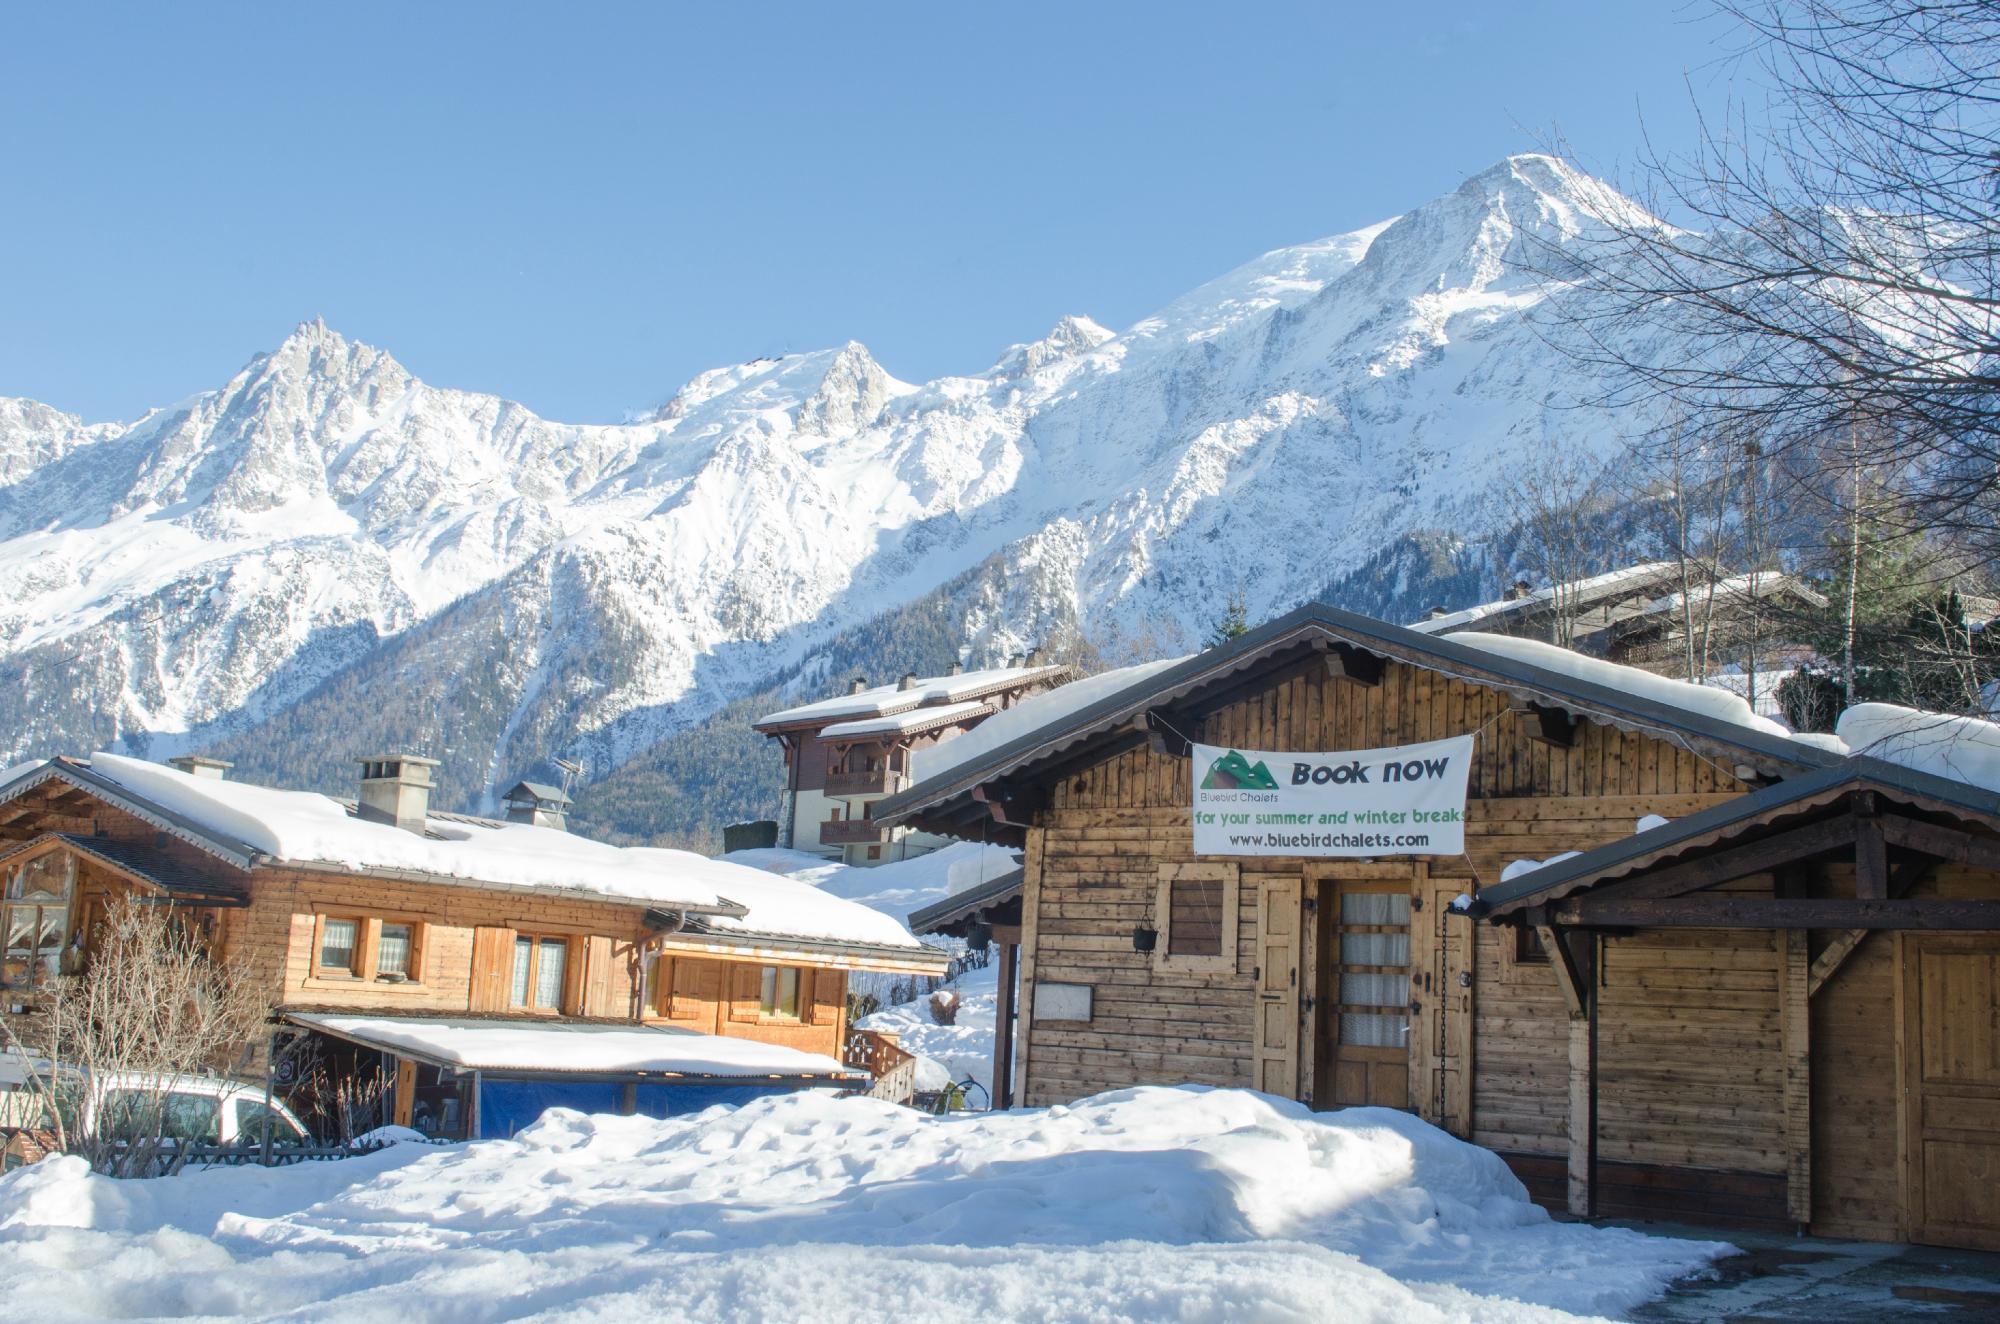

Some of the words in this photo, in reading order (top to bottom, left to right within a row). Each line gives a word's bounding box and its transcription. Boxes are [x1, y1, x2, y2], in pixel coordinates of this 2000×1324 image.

[1291, 762, 1371, 785] Book
[1383, 757, 1450, 782] now
[1200, 792, 1237, 802] Bluebird
[1240, 792, 1279, 802] Chalets
[1195, 811, 1216, 824] for
[1221, 813, 1250, 827] your
[1256, 813, 1314, 825] summer
[1318, 811, 1348, 825] and
[1354, 810, 1406, 824] winter
[1230, 833, 1429, 848] www.bluebirdchalets.com
